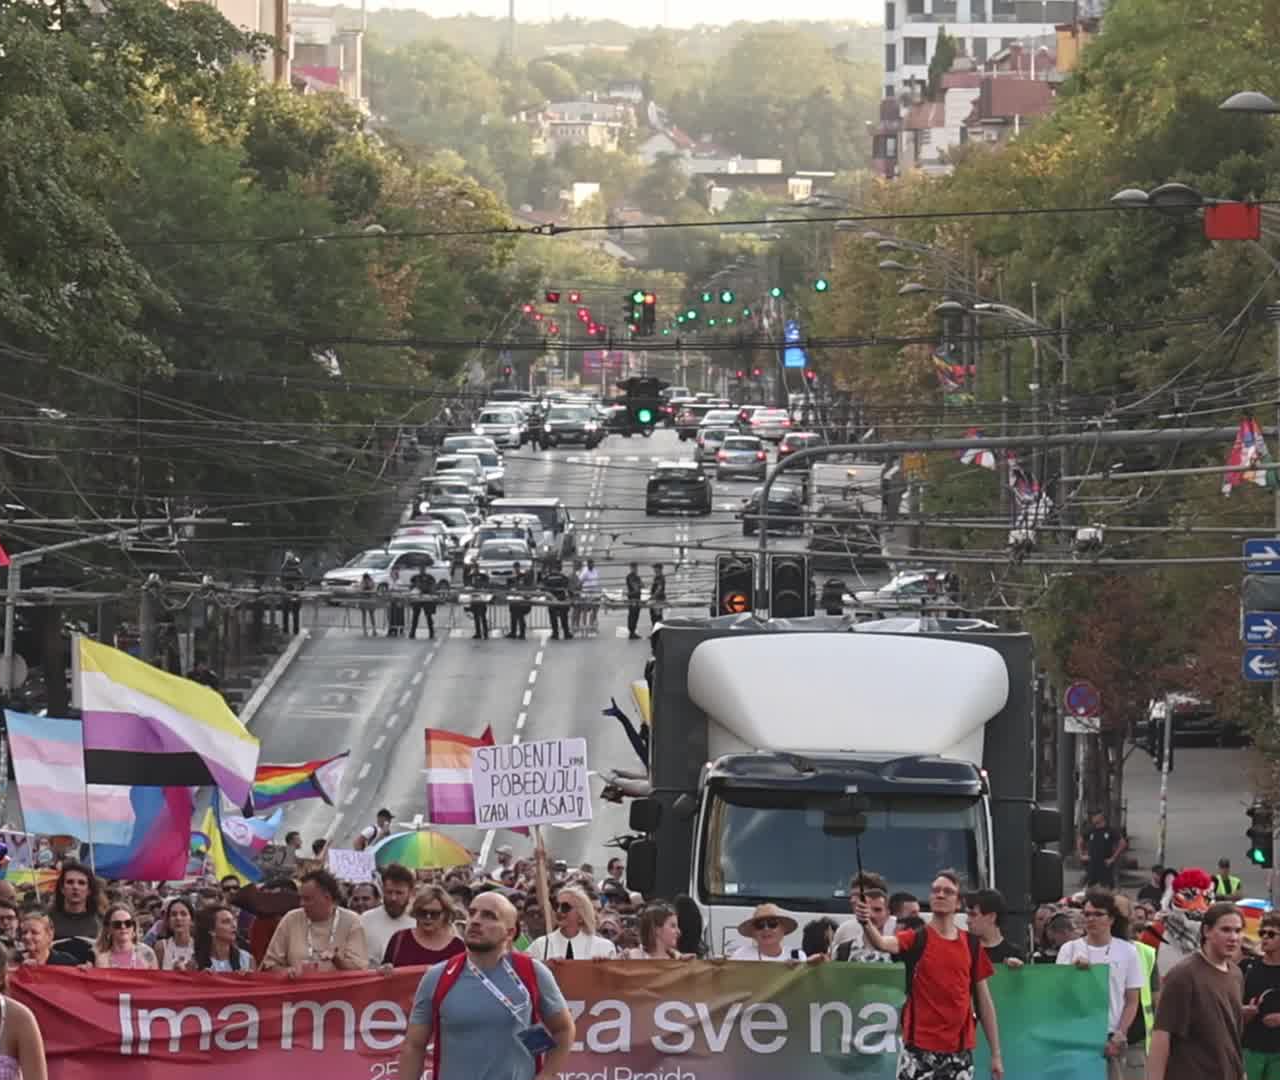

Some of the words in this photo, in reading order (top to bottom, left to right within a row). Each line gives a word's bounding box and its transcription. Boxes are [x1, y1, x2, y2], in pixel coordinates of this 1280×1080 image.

[477, 741, 562, 772] STUDENTI
[119, 993, 260, 1055] Ima
[651, 999, 789, 1054] sve
[809, 1000, 905, 1054] na
